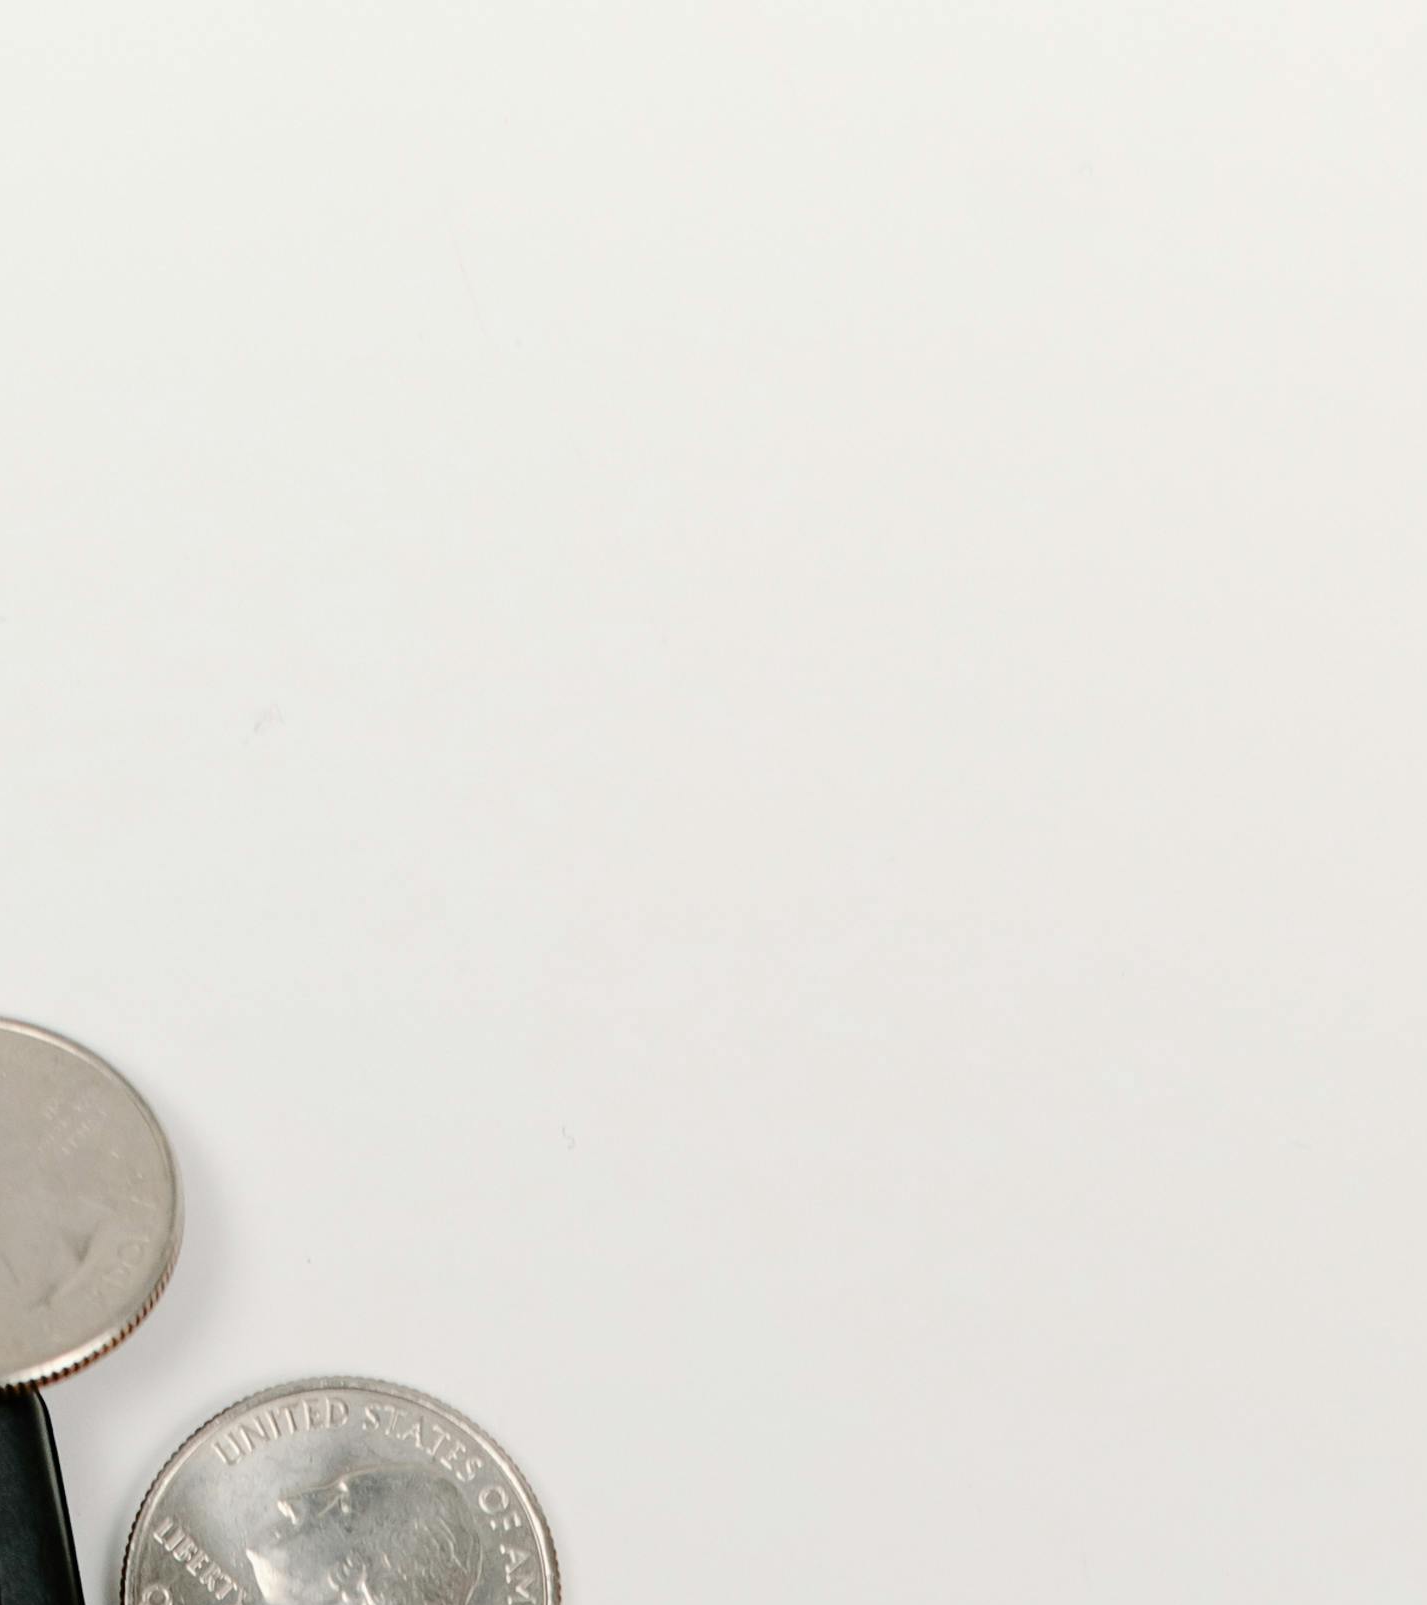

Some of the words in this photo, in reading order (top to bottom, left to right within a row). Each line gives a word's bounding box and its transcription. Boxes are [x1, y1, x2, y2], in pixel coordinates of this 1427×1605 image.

[212, 1399, 349, 1466] UNITED
[362, 1401, 484, 1482] STATES
[478, 1486, 523, 1531] OF
